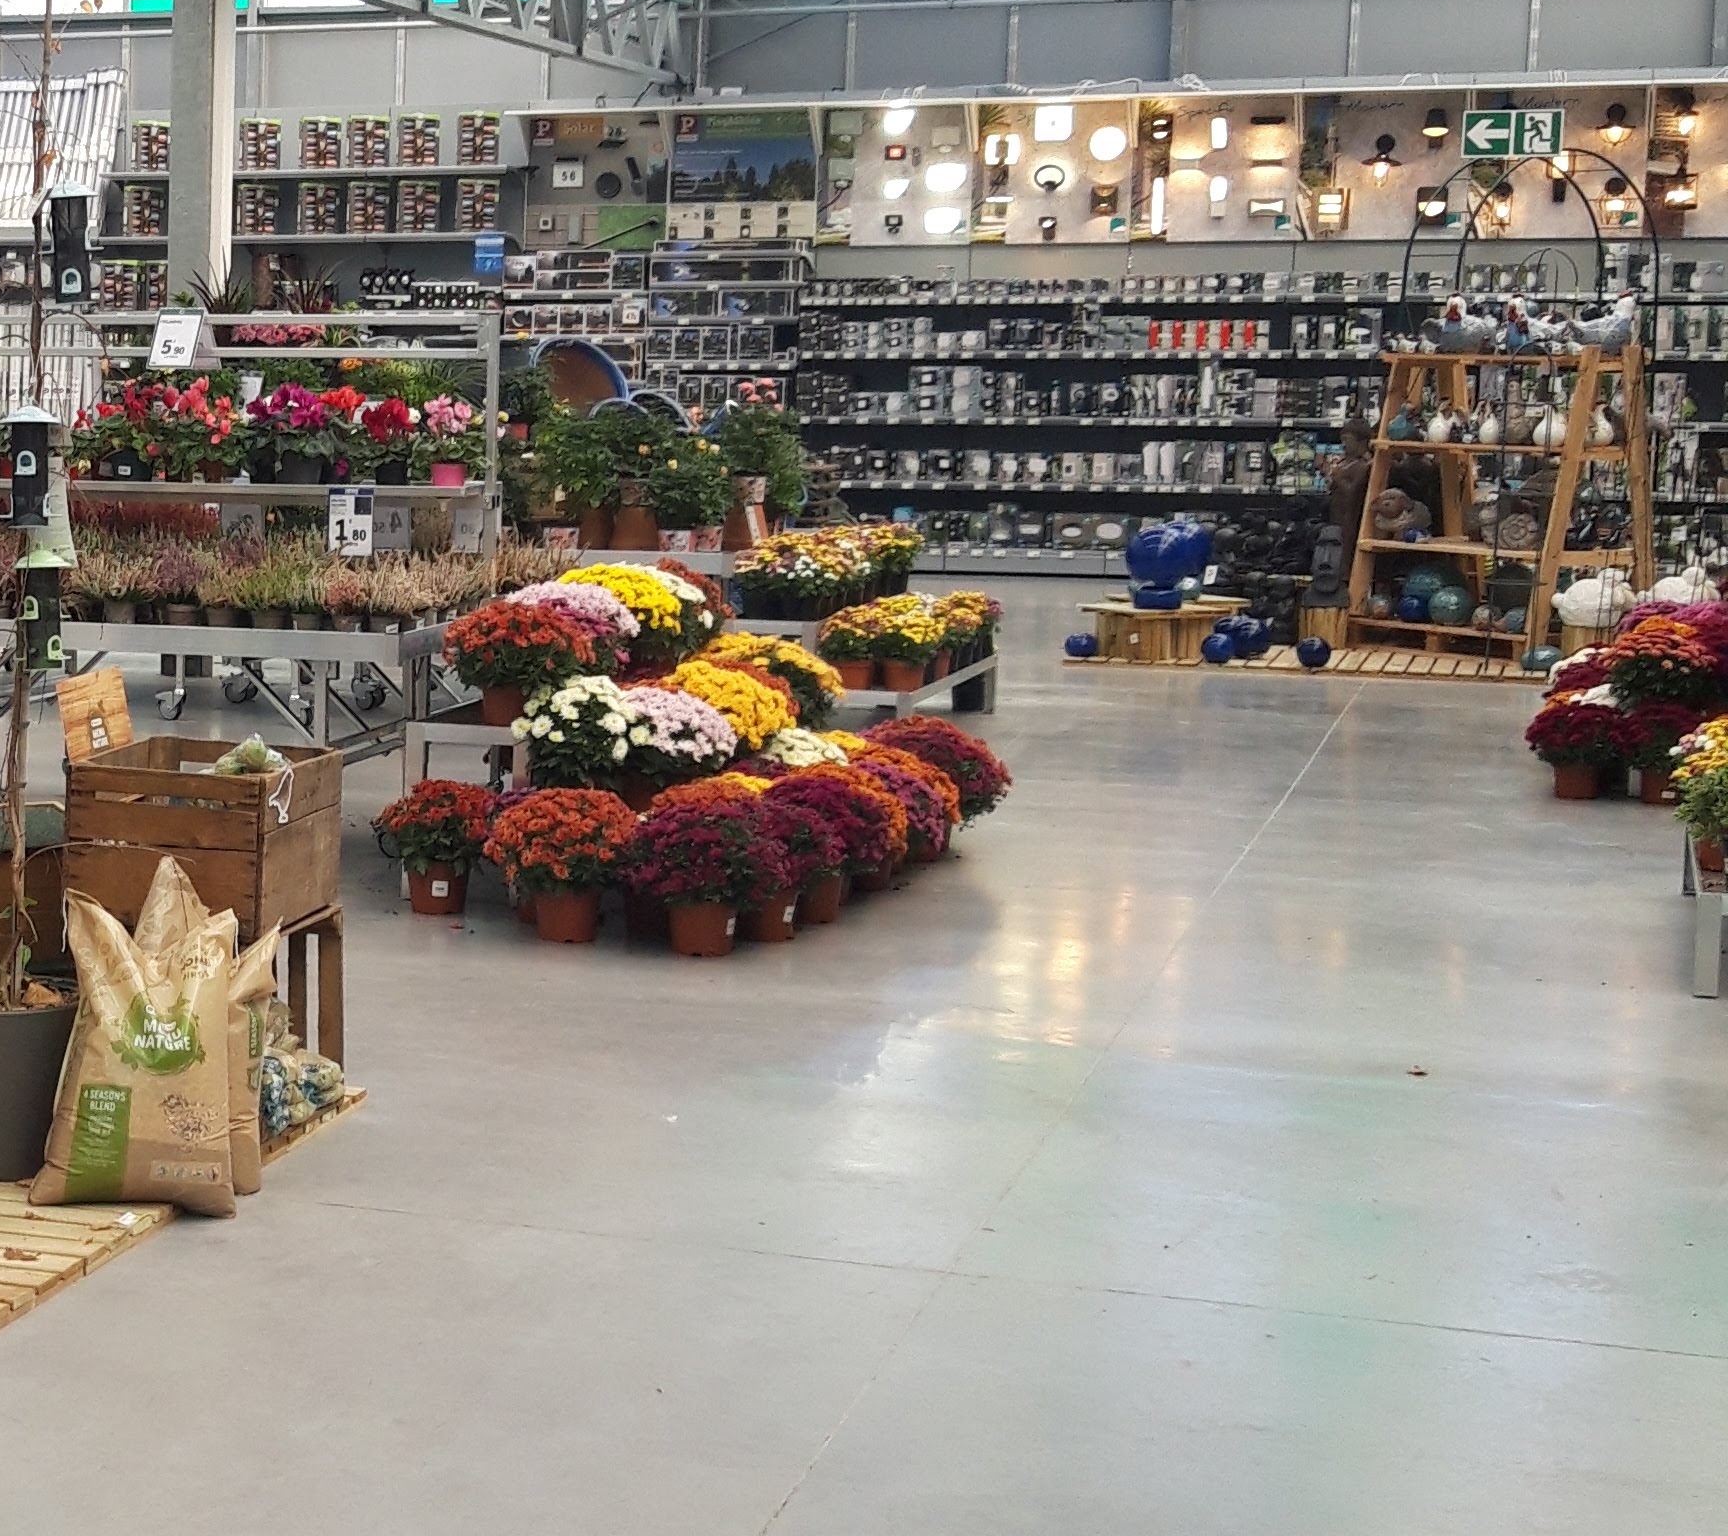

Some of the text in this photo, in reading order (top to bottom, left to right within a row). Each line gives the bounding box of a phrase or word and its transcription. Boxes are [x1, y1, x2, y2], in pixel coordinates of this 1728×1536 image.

[563, 123, 595, 136] Solar
[352, 529, 367, 541] 80
[90, 1089, 126, 1102] SEASONS
[90, 1100, 116, 1112] BLEND
